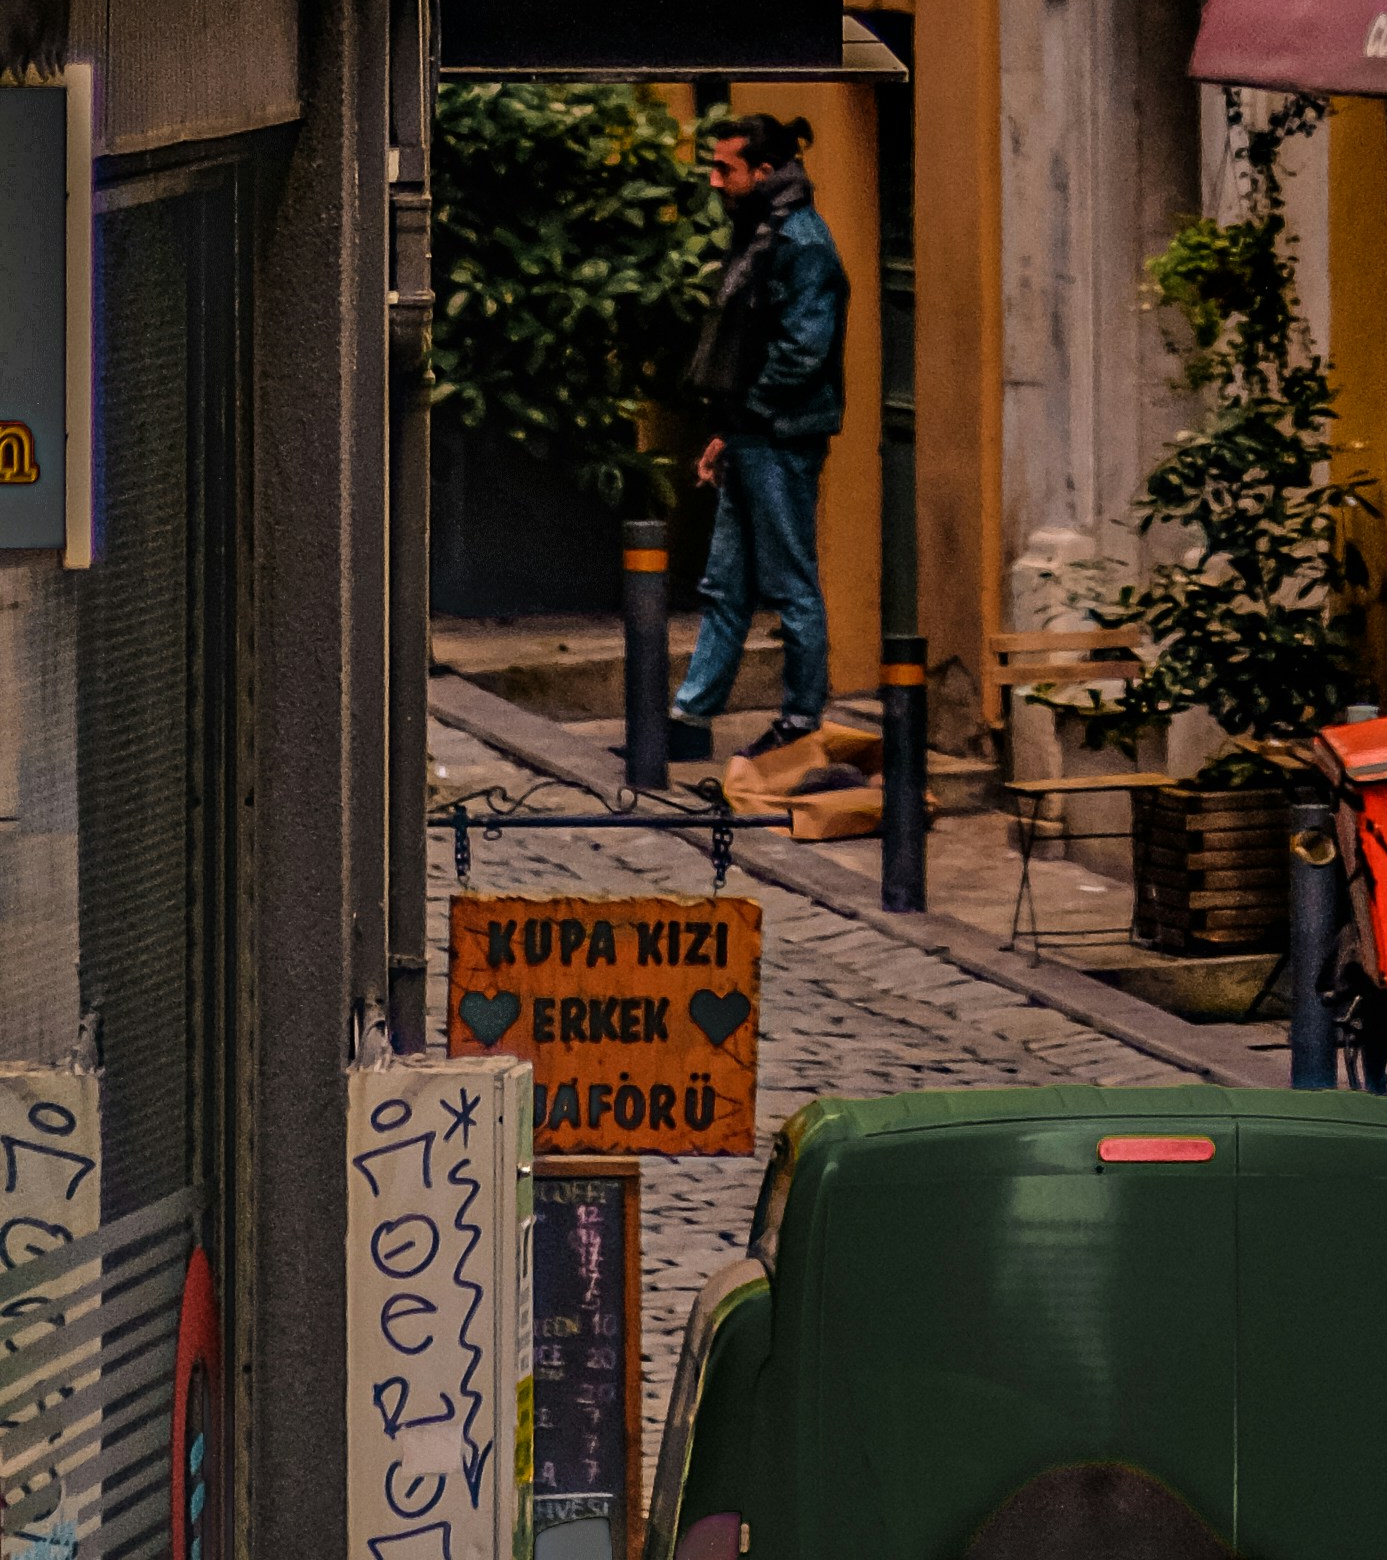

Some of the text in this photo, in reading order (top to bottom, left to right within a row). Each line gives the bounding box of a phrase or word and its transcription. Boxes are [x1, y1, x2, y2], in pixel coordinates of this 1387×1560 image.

[487, 918, 729, 968] KUPA KIZI
[533, 995, 670, 1045] ERKEK
